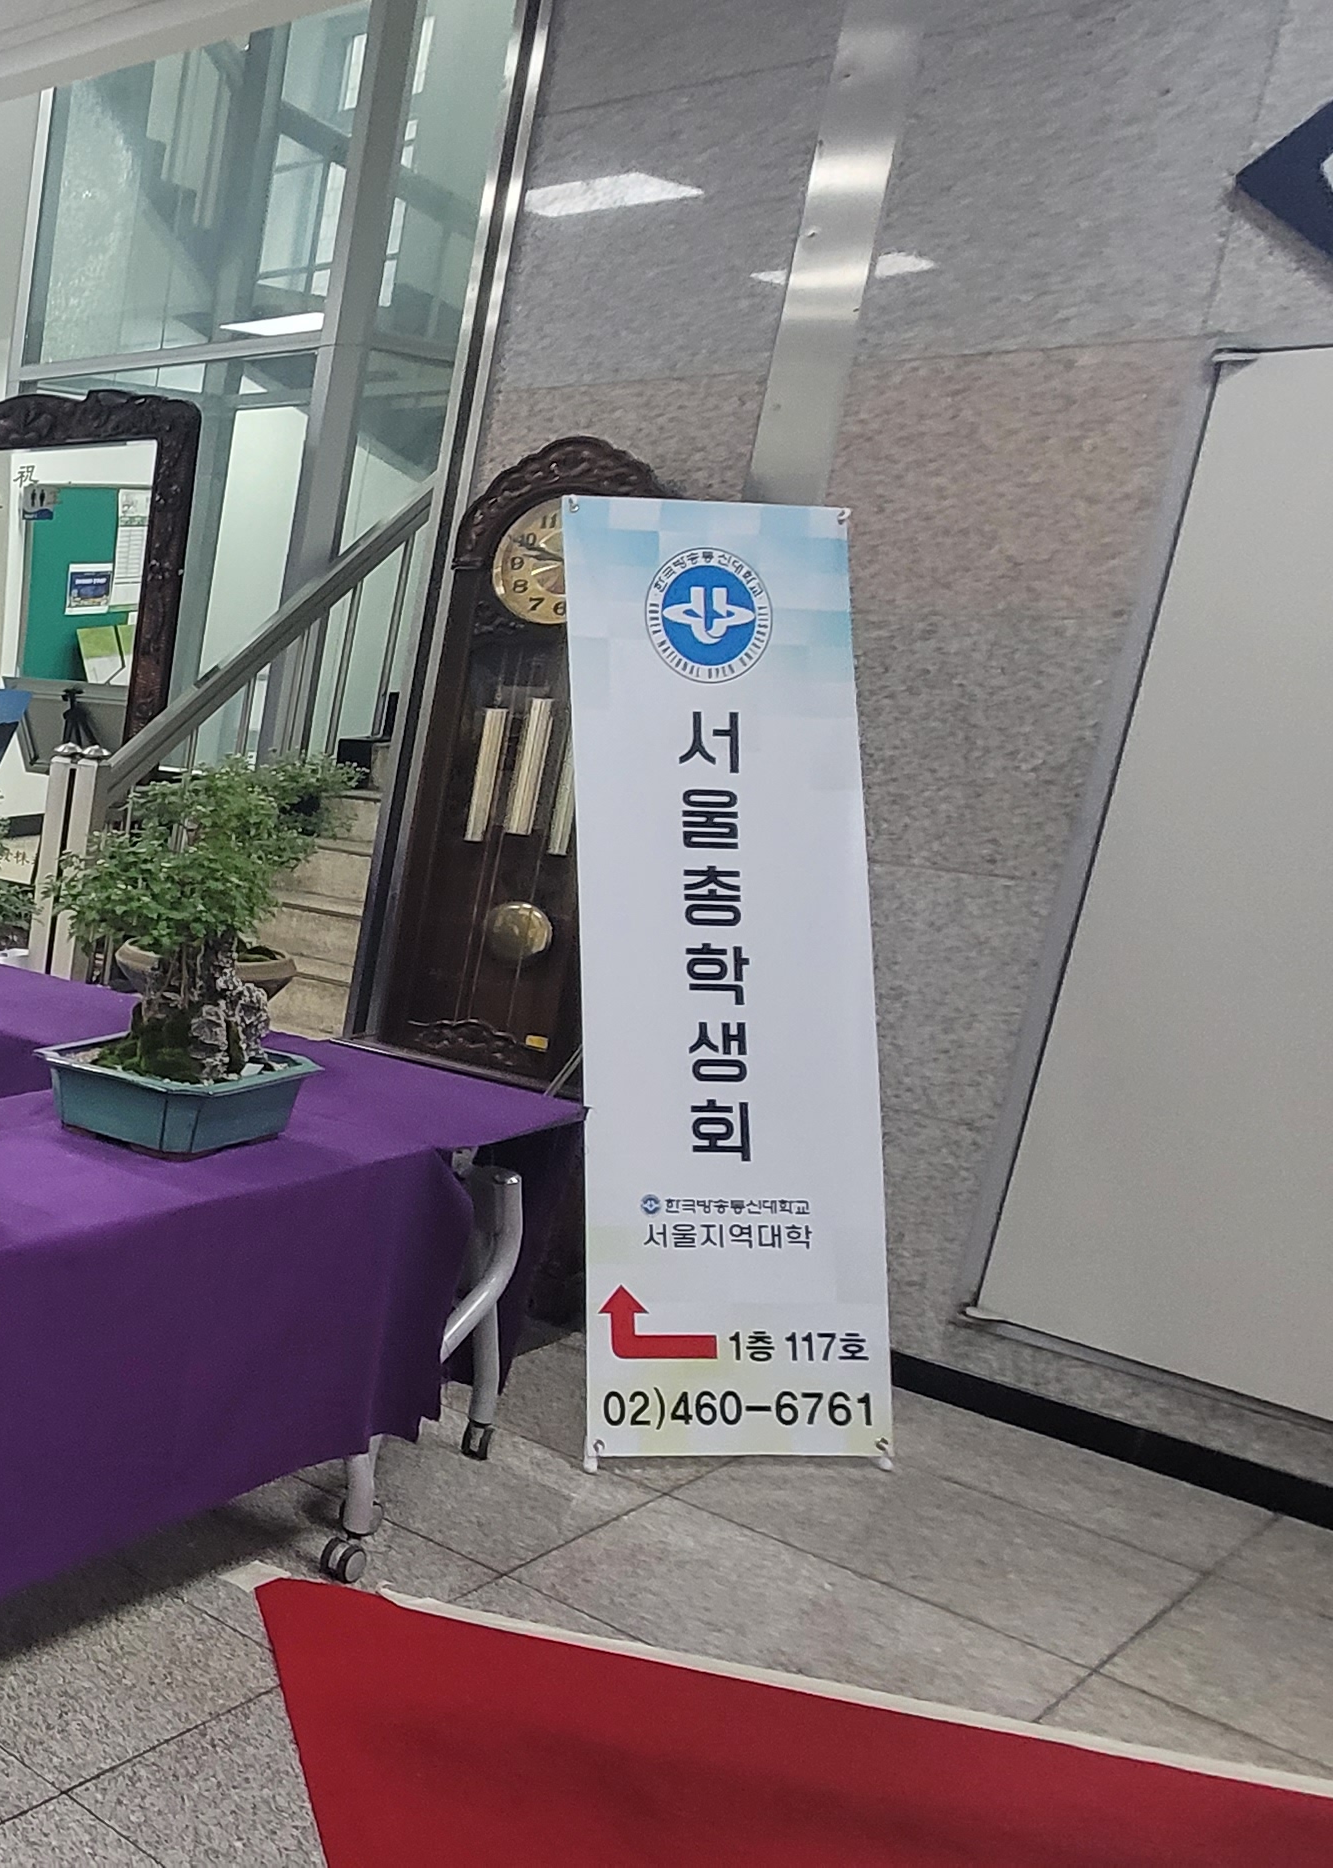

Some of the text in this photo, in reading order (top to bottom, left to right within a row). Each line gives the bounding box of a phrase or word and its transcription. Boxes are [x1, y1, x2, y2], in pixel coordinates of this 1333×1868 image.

[13, 465, 39, 488] 祝
[540, 514, 558, 529] 11
[510, 556, 525, 571] 9
[653, 551, 764, 598] 한국방송통신대학교
[512, 579, 528, 593] 8
[529, 597, 545, 611] 7
[553, 601, 566, 616] 6
[648, 603, 769, 679] KOREA NATIONAL OPEN UNIVERSITY
[678, 711, 752, 1162] 서울총학생회
[665, 1198, 811, 1215] 한국방송통신대학교
[643, 1223, 813, 1250] 서울지역대학
[729, 1330, 870, 1362] 1층 117호
[603, 1387, 874, 1429] 02)460-6761
